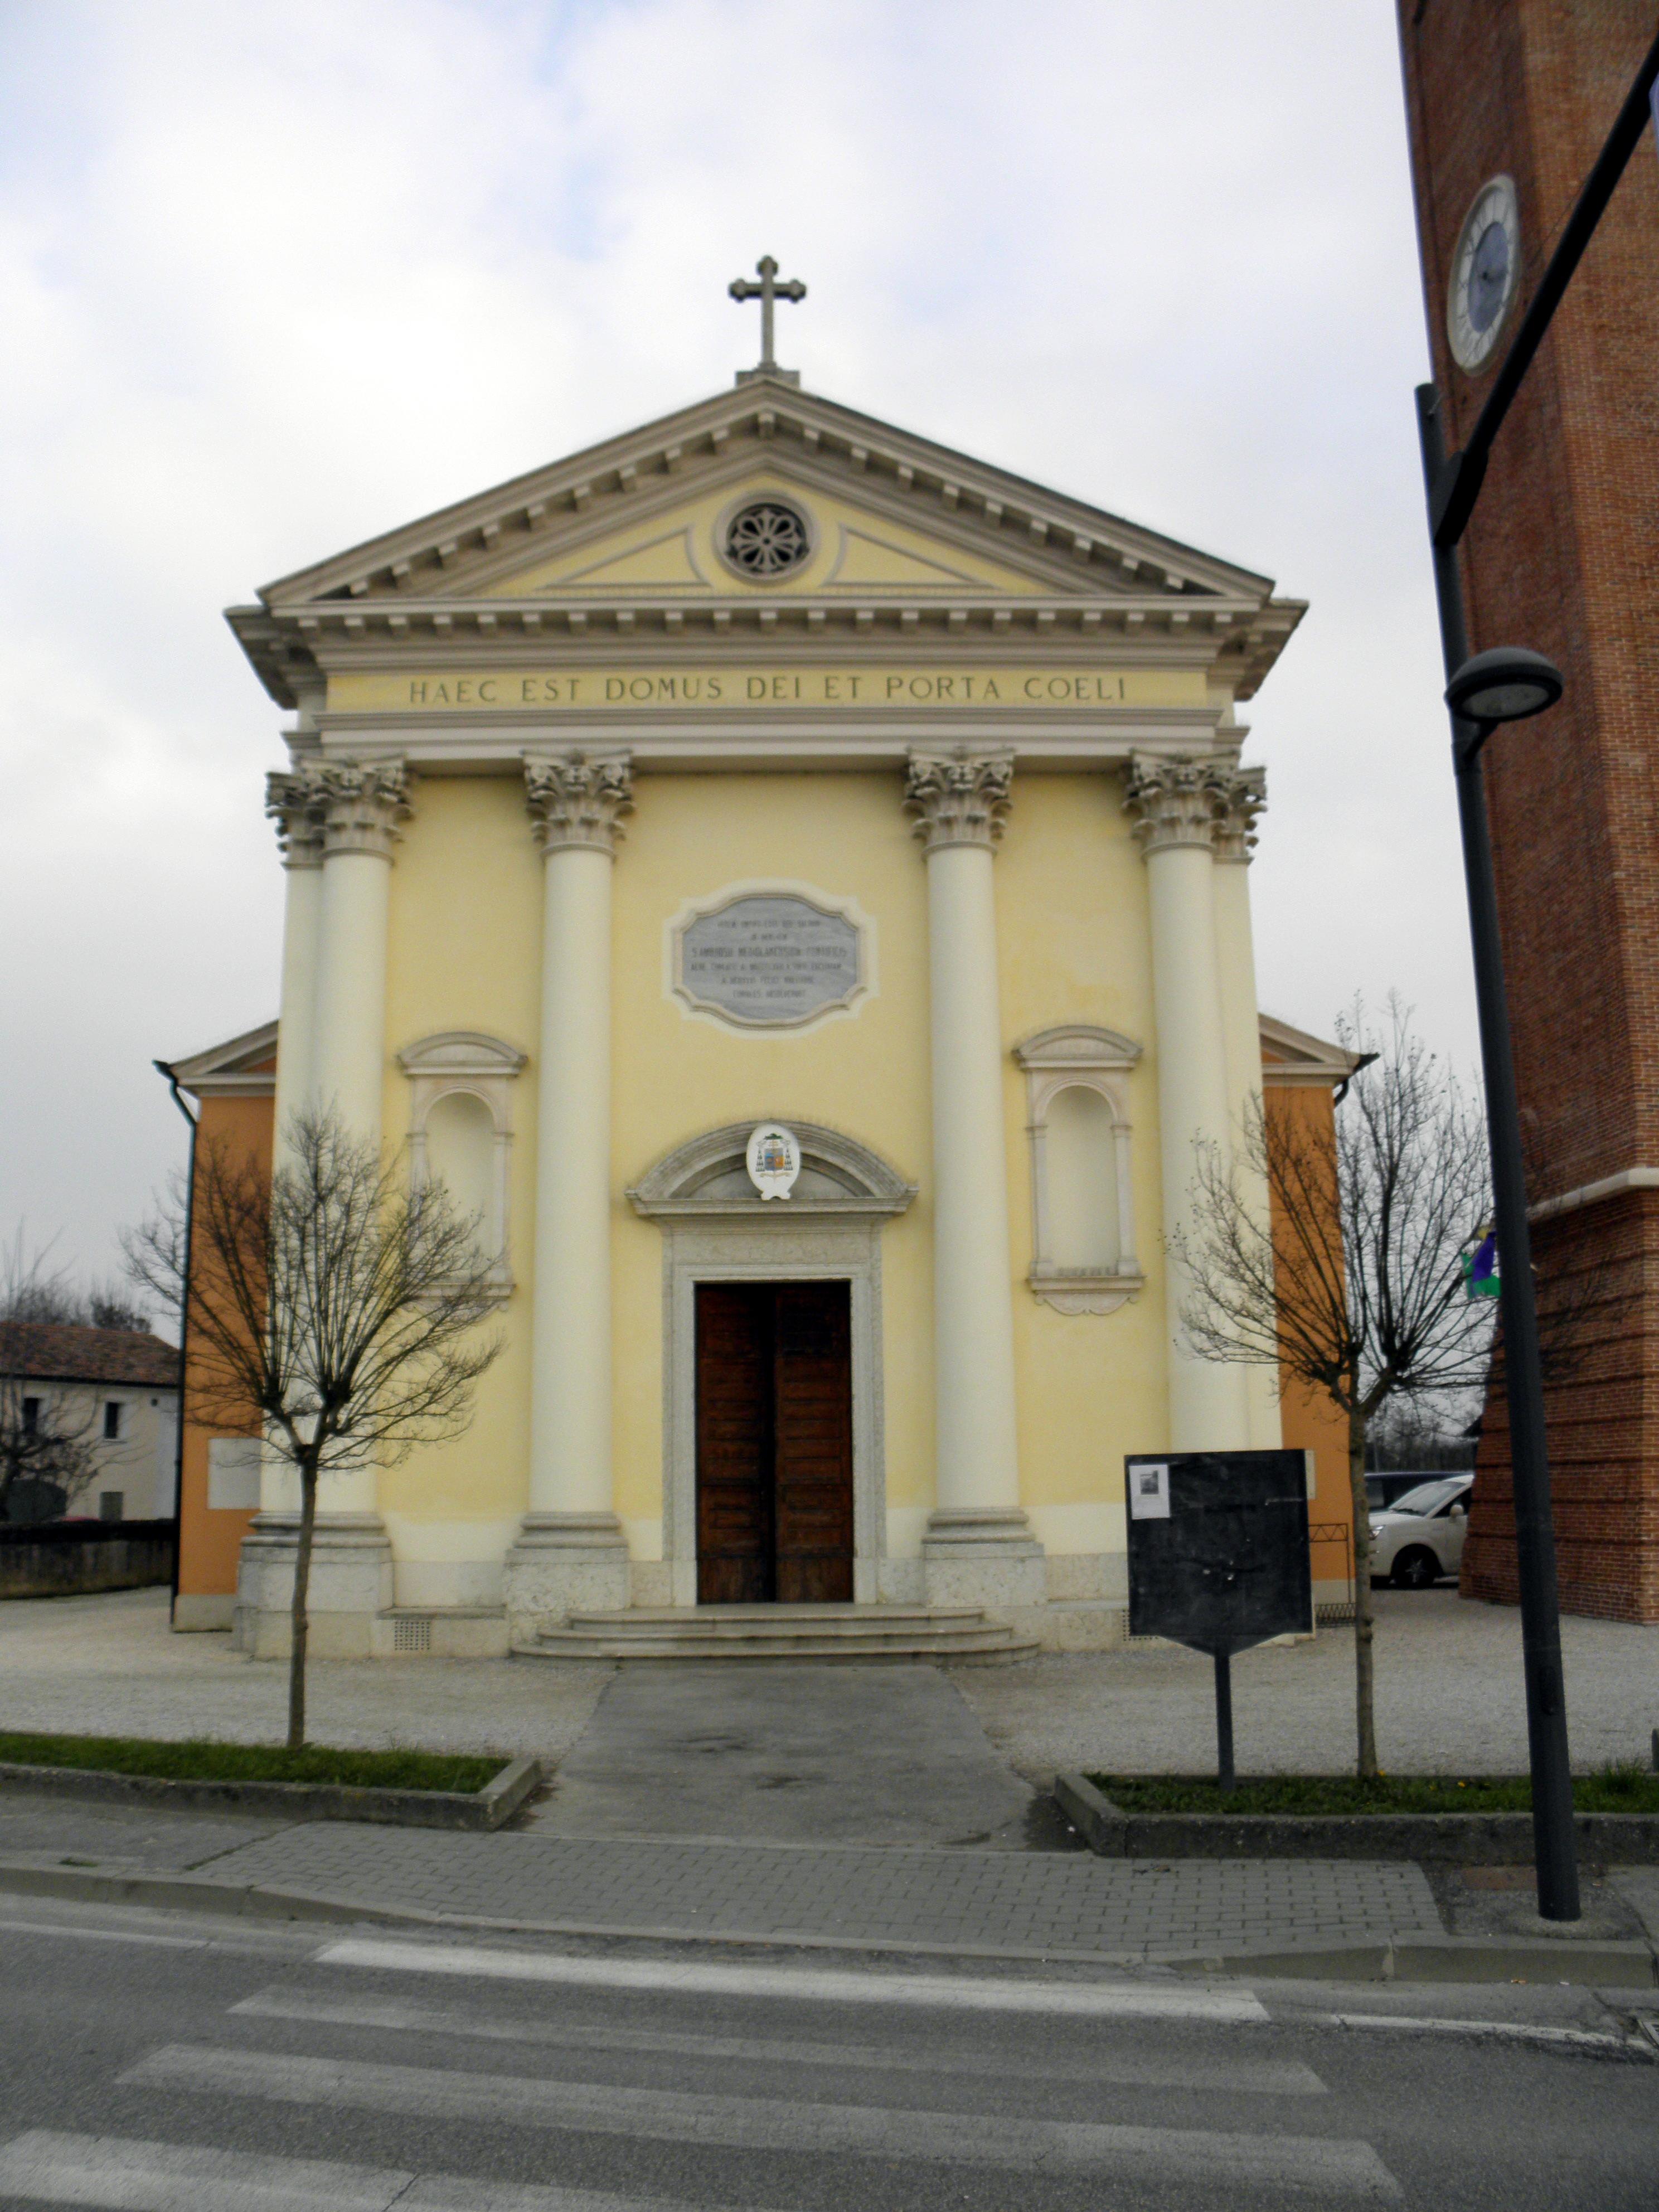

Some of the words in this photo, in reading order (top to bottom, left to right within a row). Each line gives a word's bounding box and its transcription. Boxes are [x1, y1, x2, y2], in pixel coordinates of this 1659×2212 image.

[410, 680, 497, 704] HAEC
[521, 678, 580, 702] EST
[605, 676, 722, 701] DOMUS
[746, 676, 801, 700] DEI
[824, 676, 864, 699] ET
[886, 676, 1001, 699] PORTA
[1023, 676, 1126, 700] COELI
